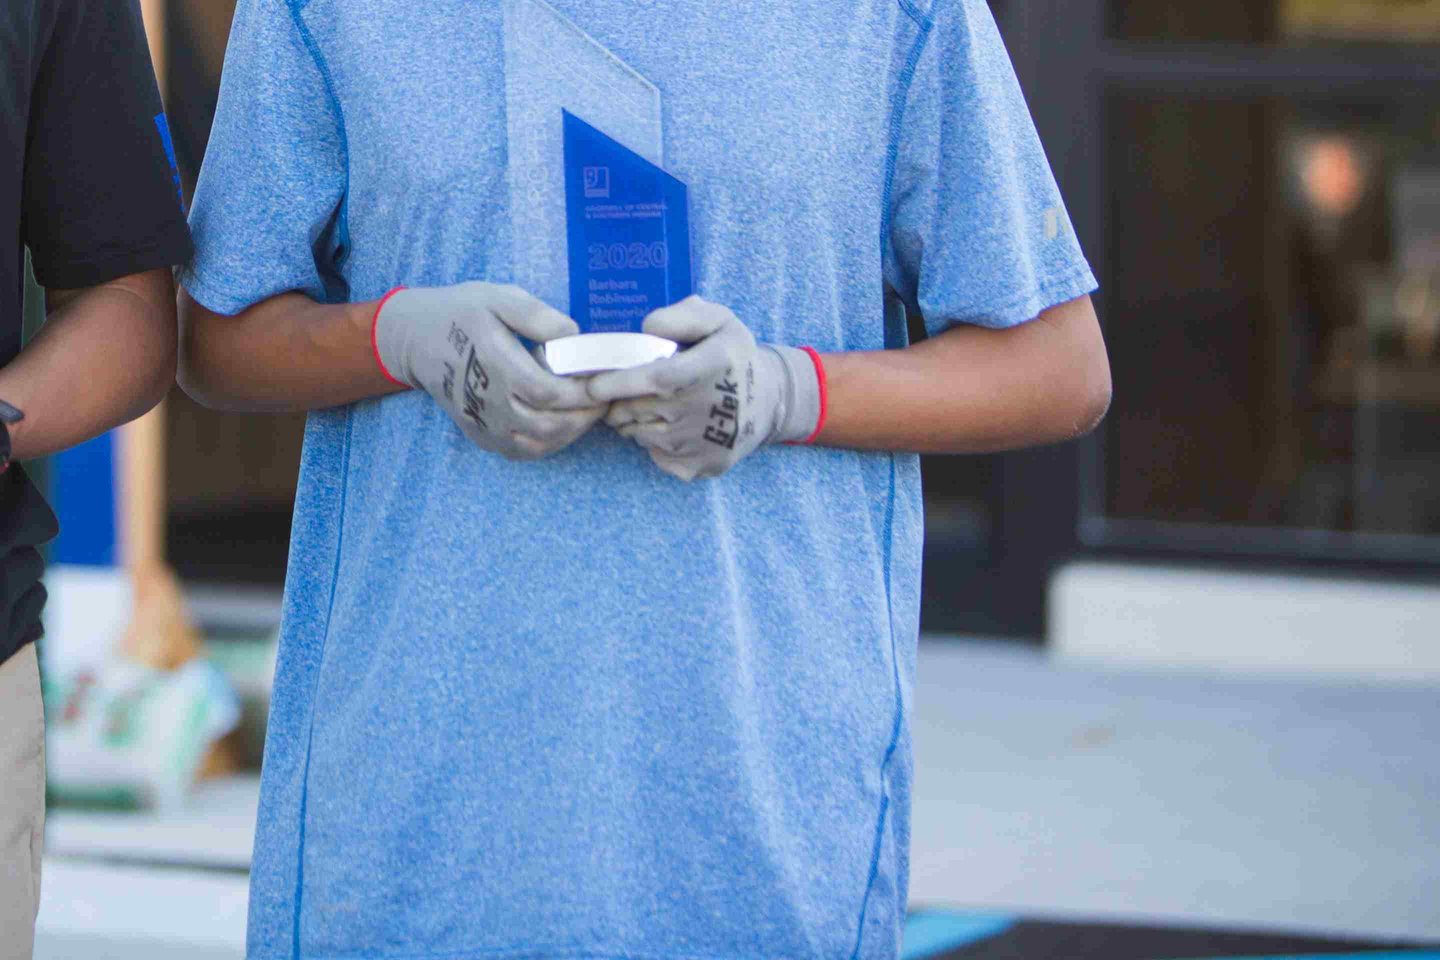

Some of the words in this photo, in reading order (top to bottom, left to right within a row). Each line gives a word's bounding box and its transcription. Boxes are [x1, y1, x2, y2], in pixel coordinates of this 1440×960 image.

[588, 242, 667, 269] 2020
[589, 279, 638, 290] Barbara
[589, 292, 648, 305] Robinson
[703, 377, 738, 450] G-Tek
